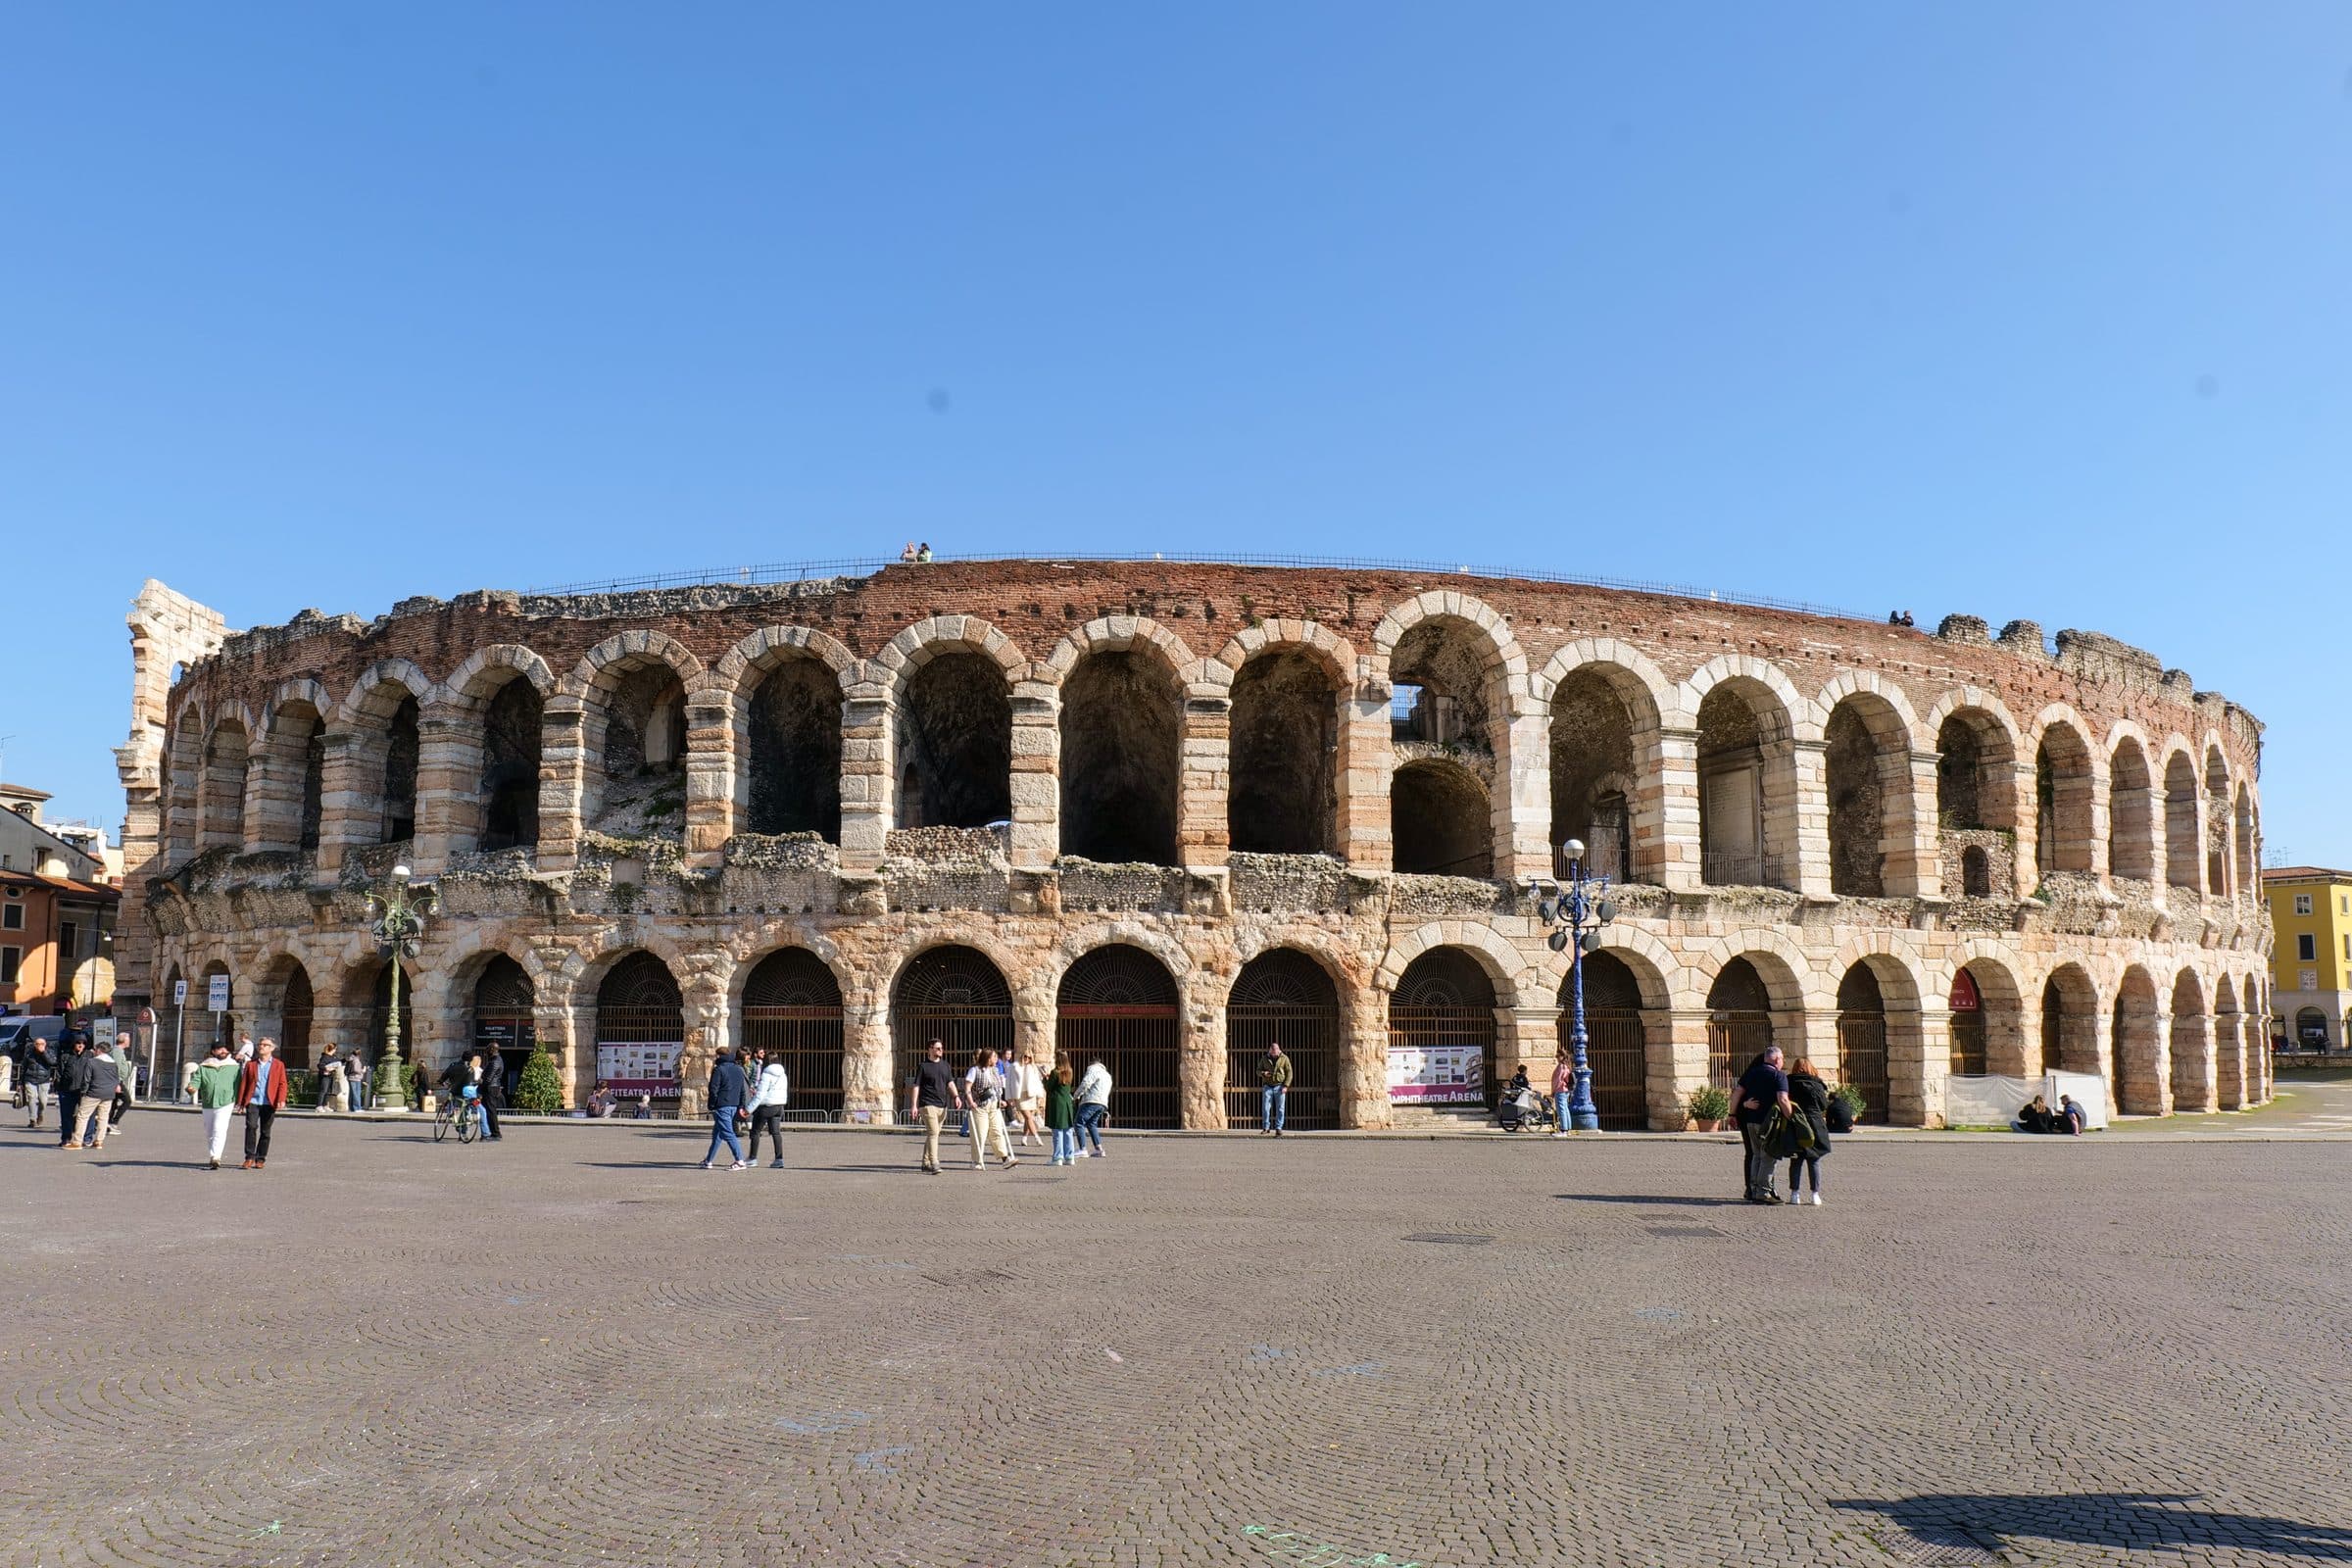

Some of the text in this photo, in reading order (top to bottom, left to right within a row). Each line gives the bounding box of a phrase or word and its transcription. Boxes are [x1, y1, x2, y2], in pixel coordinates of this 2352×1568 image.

[610, 1085, 681, 1097] FITEATRO AREN
[1449, 1090, 1484, 1102] ARENA
